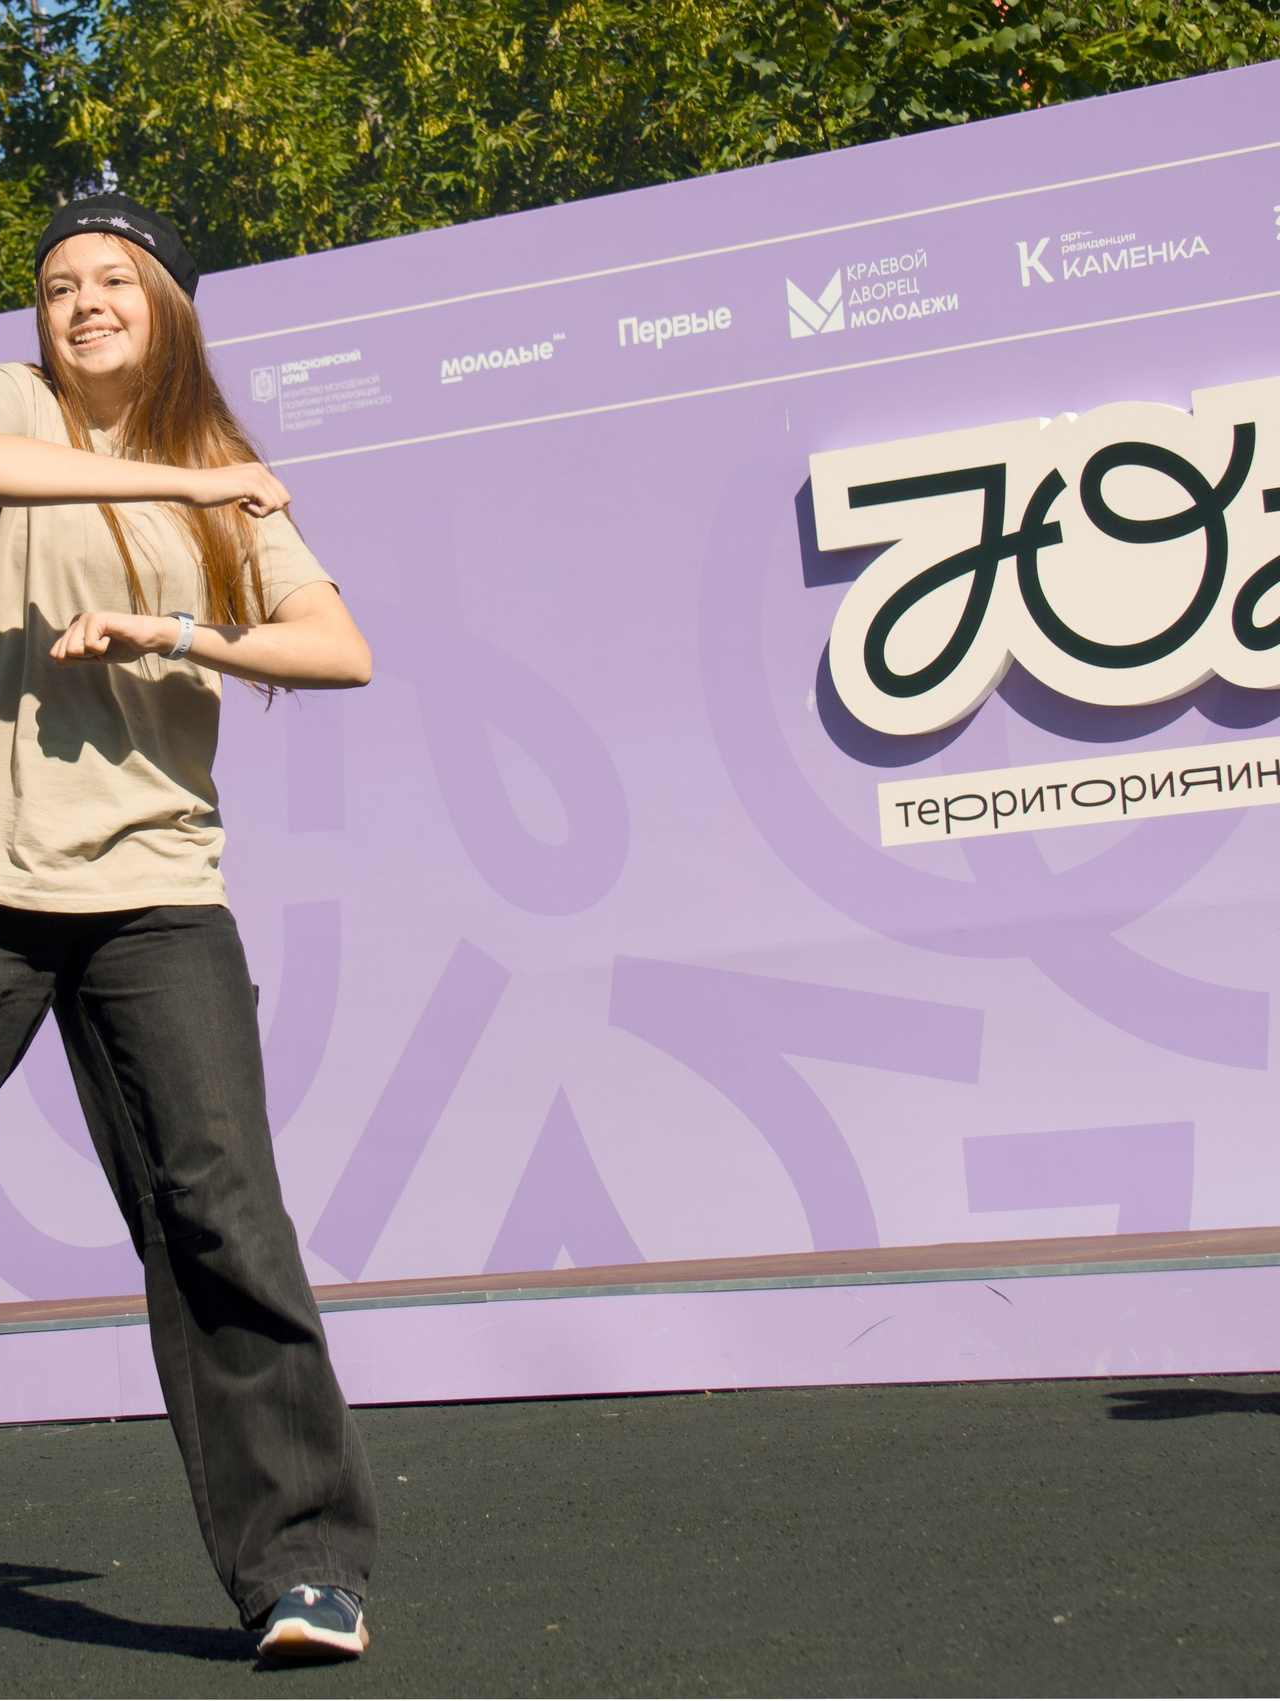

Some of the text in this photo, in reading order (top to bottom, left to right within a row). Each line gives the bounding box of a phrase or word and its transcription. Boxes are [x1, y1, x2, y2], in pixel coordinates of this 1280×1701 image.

[1061, 233, 1136, 254] резиденция
[1062, 236, 1210, 280] КАМЕНКА
[846, 248, 928, 282] КРАЕВОЙ
[848, 276, 920, 307] ДВОРЕЦ
[850, 293, 959, 329] МОЛОДЕЖИ
[618, 306, 732, 350] Первые
[281, 348, 362, 374] КРАСНОЯРСКИЙ
[282, 370, 309, 386] КРАЙ
